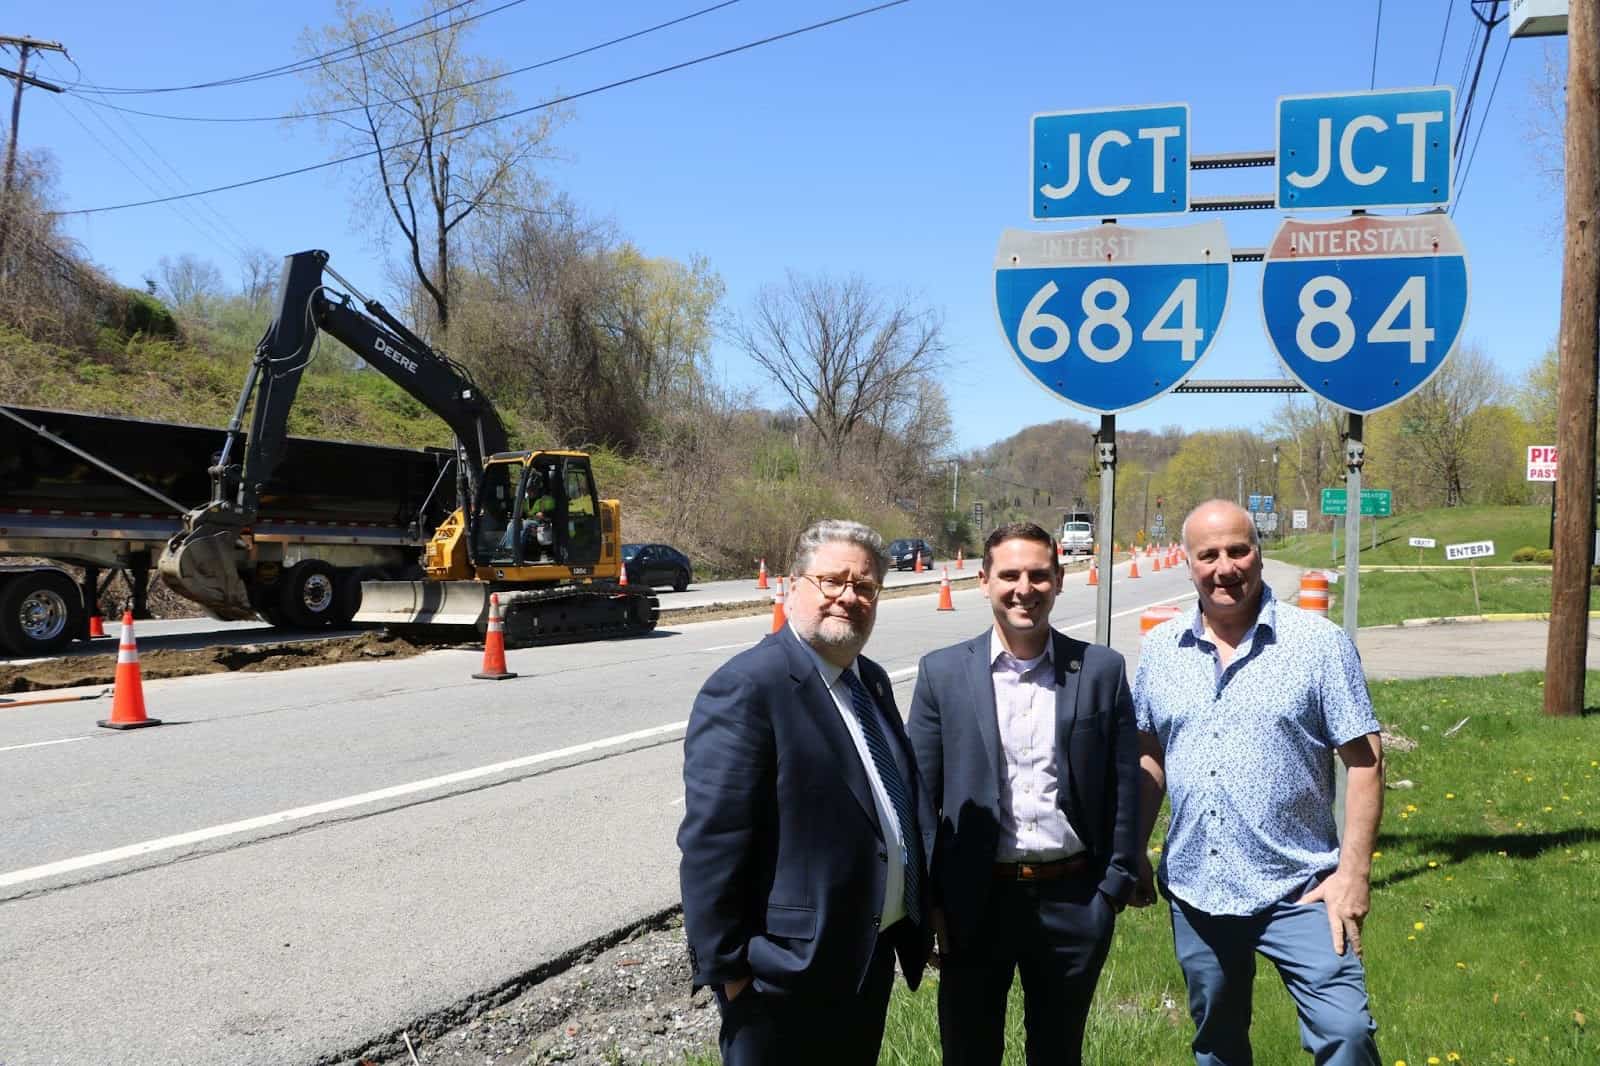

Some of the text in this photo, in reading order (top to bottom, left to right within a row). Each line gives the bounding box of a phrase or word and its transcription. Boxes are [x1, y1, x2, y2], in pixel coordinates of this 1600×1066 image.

[1040, 126, 1180, 199] JCT
[1286, 111, 1443, 189] JCT
[1042, 236, 1130, 258] INTERST
[1291, 225, 1436, 255] INTERSTATE
[1017, 278, 1204, 363] 684
[1295, 275, 1435, 363] 84
[374, 336, 418, 374] DEERE
[1449, 545, 1484, 558] ENTER
